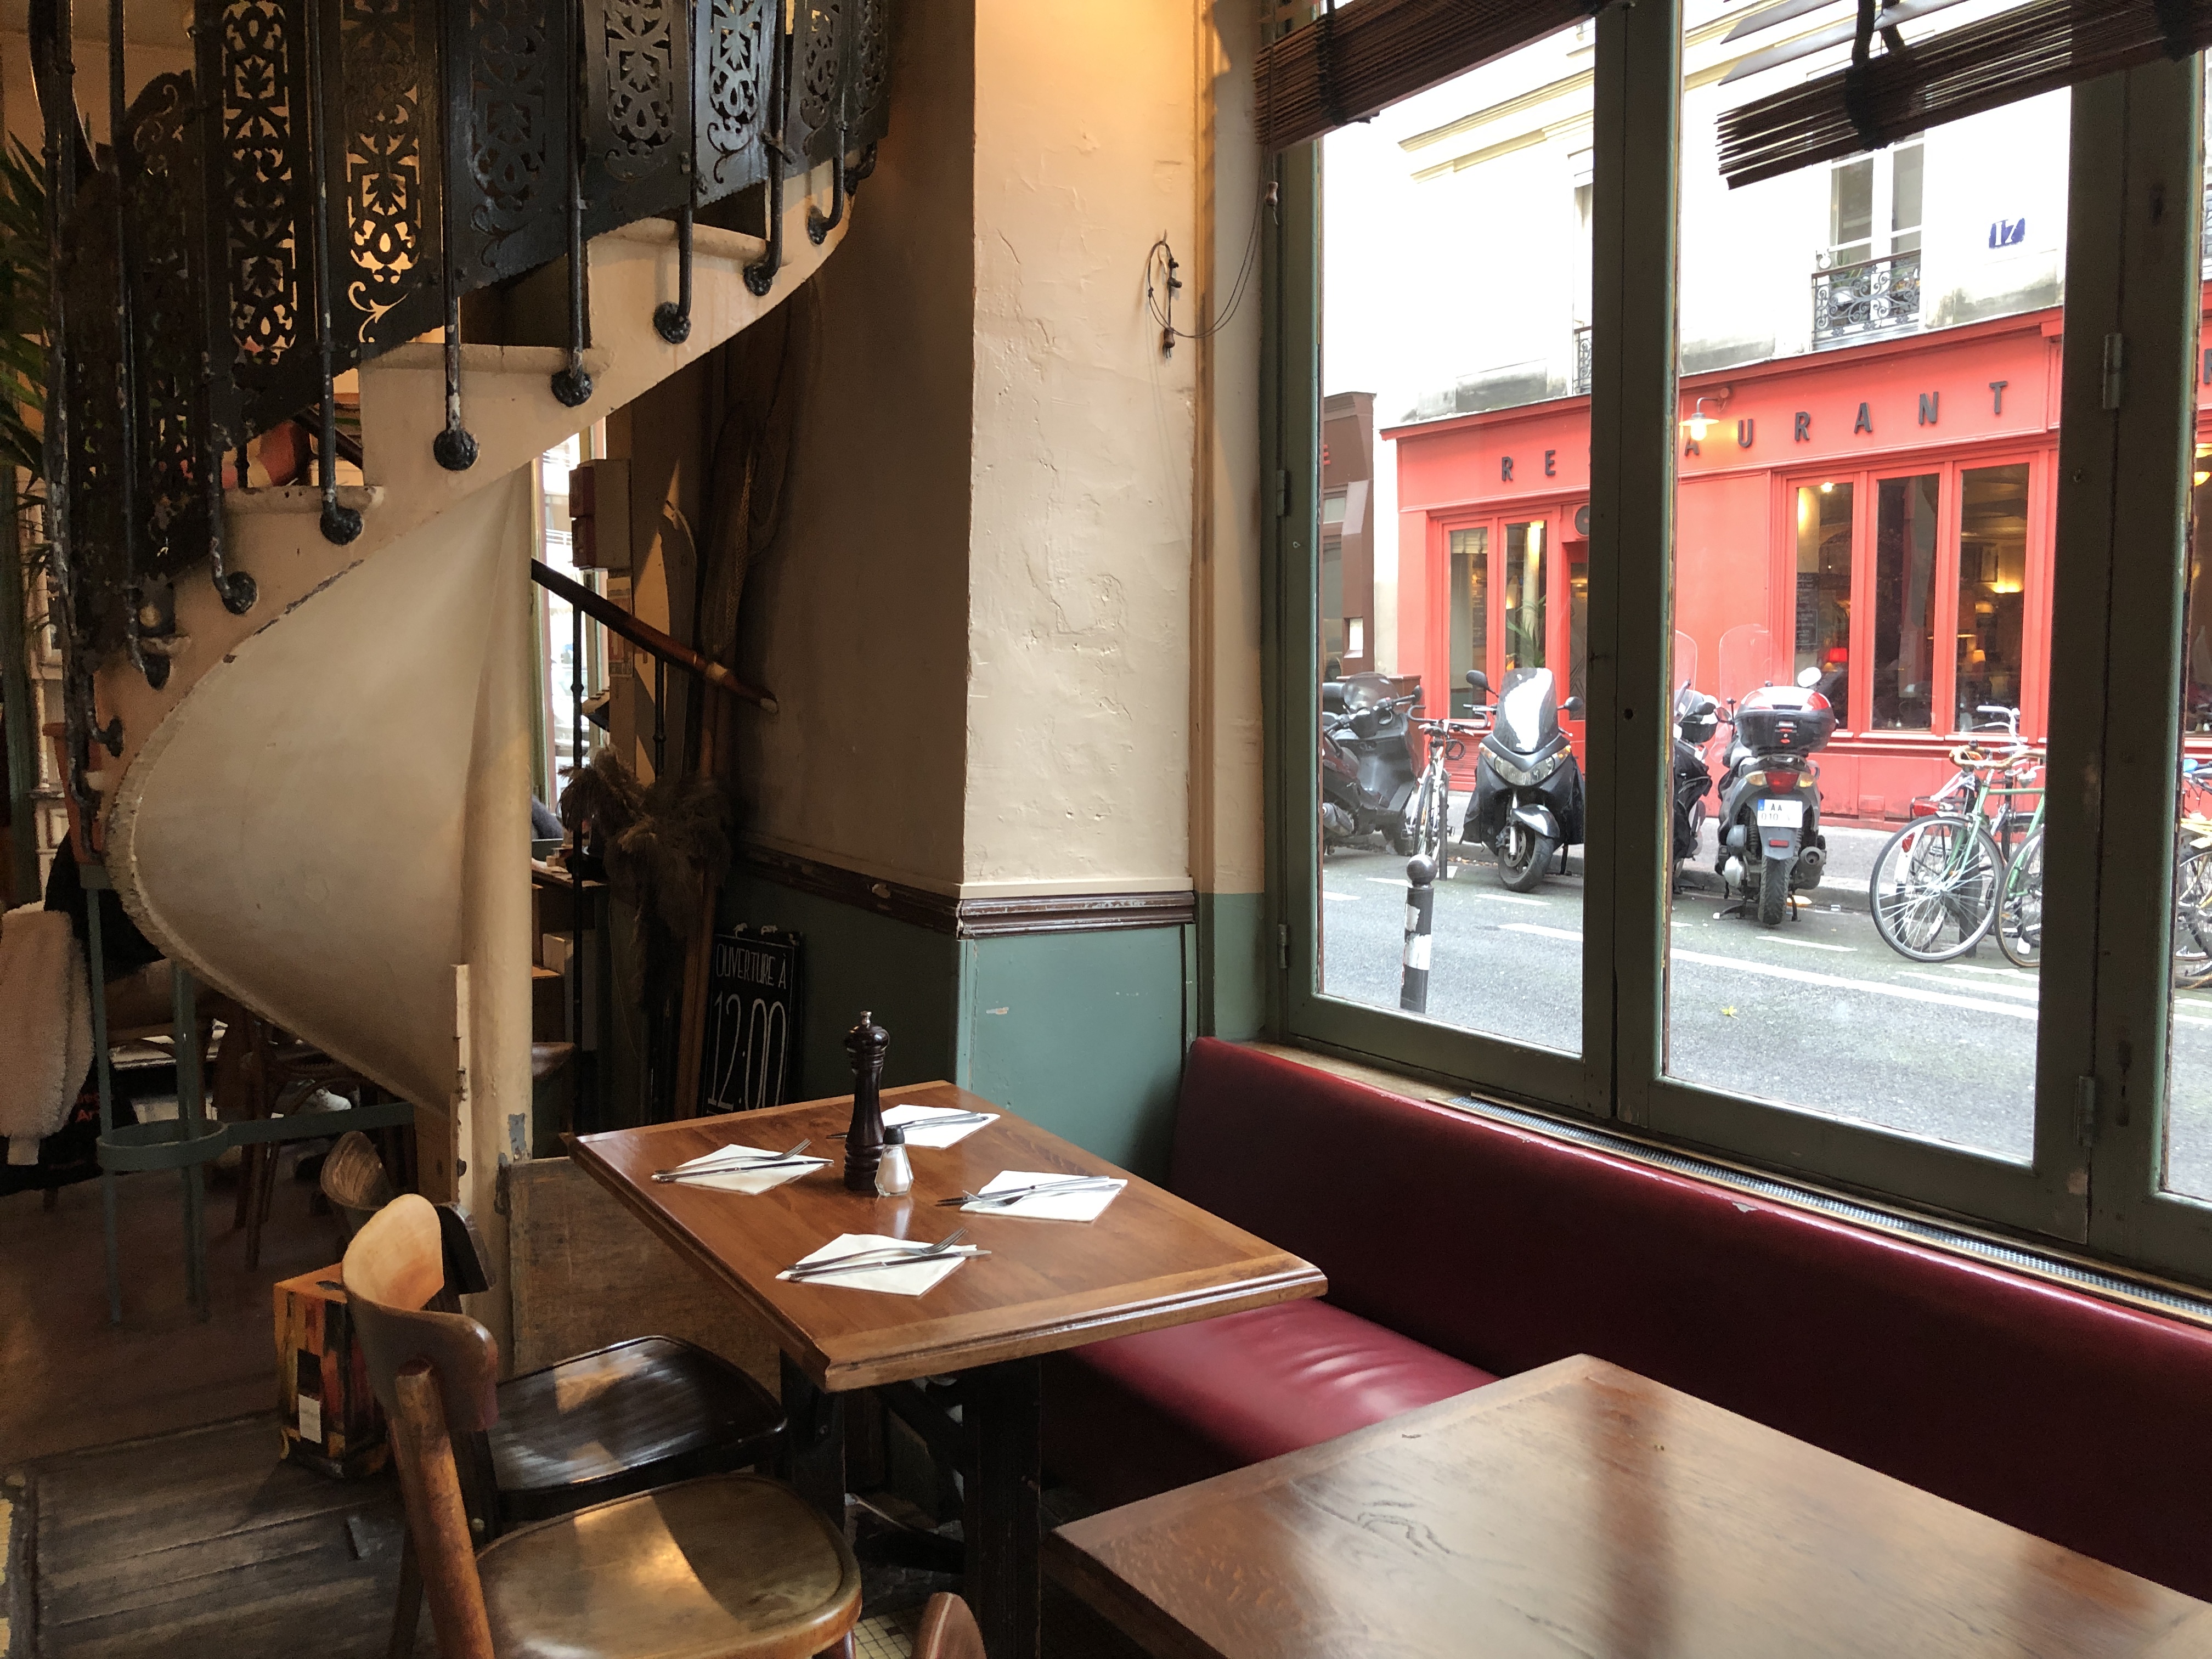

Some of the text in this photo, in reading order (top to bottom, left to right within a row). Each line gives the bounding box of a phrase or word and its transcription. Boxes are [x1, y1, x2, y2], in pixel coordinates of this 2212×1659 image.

[1994, 218, 2021, 246] 17
[1502, 380, 2008, 482] REAURANT
[715, 943, 775, 986] OUVERTURE
